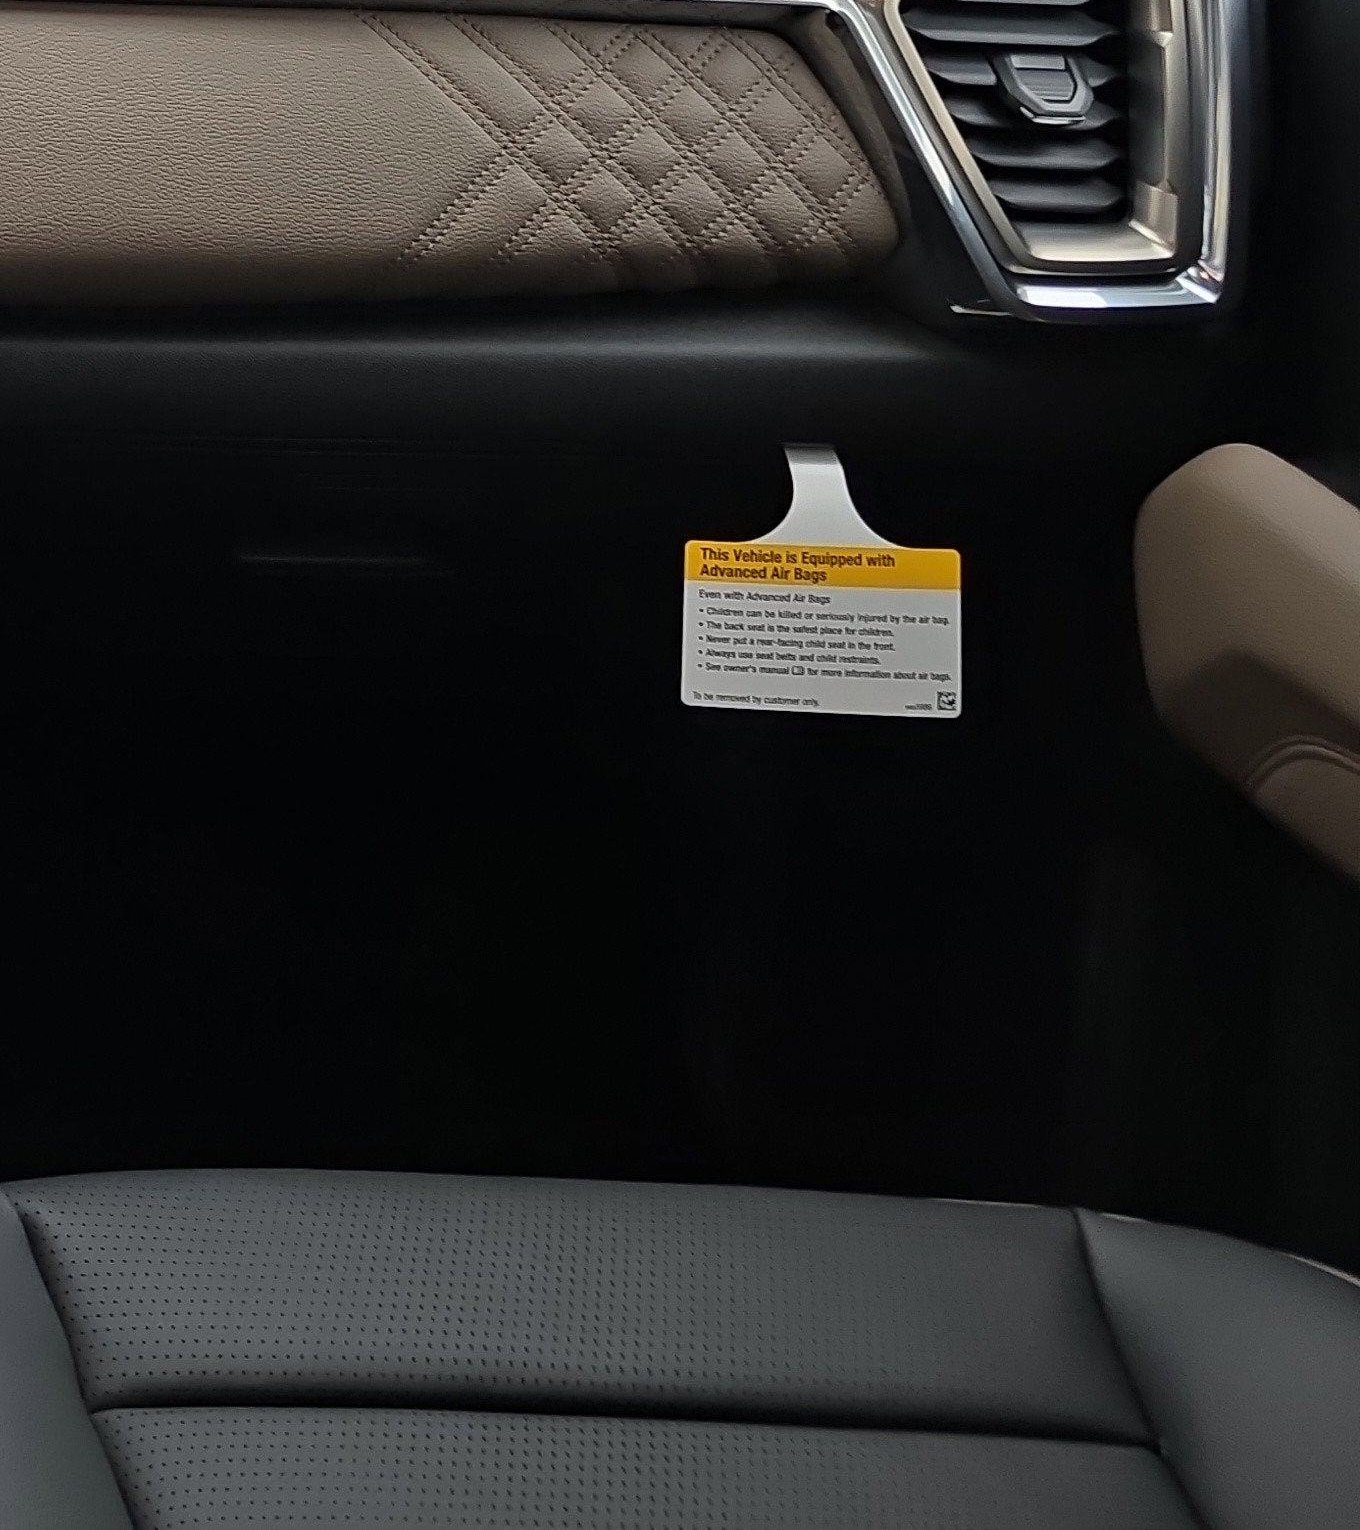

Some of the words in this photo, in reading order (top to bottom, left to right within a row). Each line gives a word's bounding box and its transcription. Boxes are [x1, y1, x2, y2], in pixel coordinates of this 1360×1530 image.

[700, 547, 729, 562] This
[733, 548, 781, 564] Vehicle
[785, 551, 797, 564] is
[801, 551, 863, 567] Equipped
[866, 553, 896, 568] with
[699, 563, 767, 581] Advanced
[771, 566, 791, 580] Air
[794, 569, 828, 584] Bags
[699, 589, 721, 599] Even
[724, 591, 744, 601] with
[747, 591, 791, 603] Advanced
[793, 593, 806, 603] Air
[808, 594, 831, 605] Bags
[706, 606, 744, 617] Children
[746, 609, 762, 619] can
[764, 609, 776, 619] be
[778, 610, 803, 621] killed
[903, 616, 916, 624] the
[706, 621, 722, 630] The
[724, 622, 744, 631] back
[776, 624, 790, 633] the
[705, 635, 731, 645] Never
[858, 641, 872, 650] the
[705, 662, 722, 672] See
